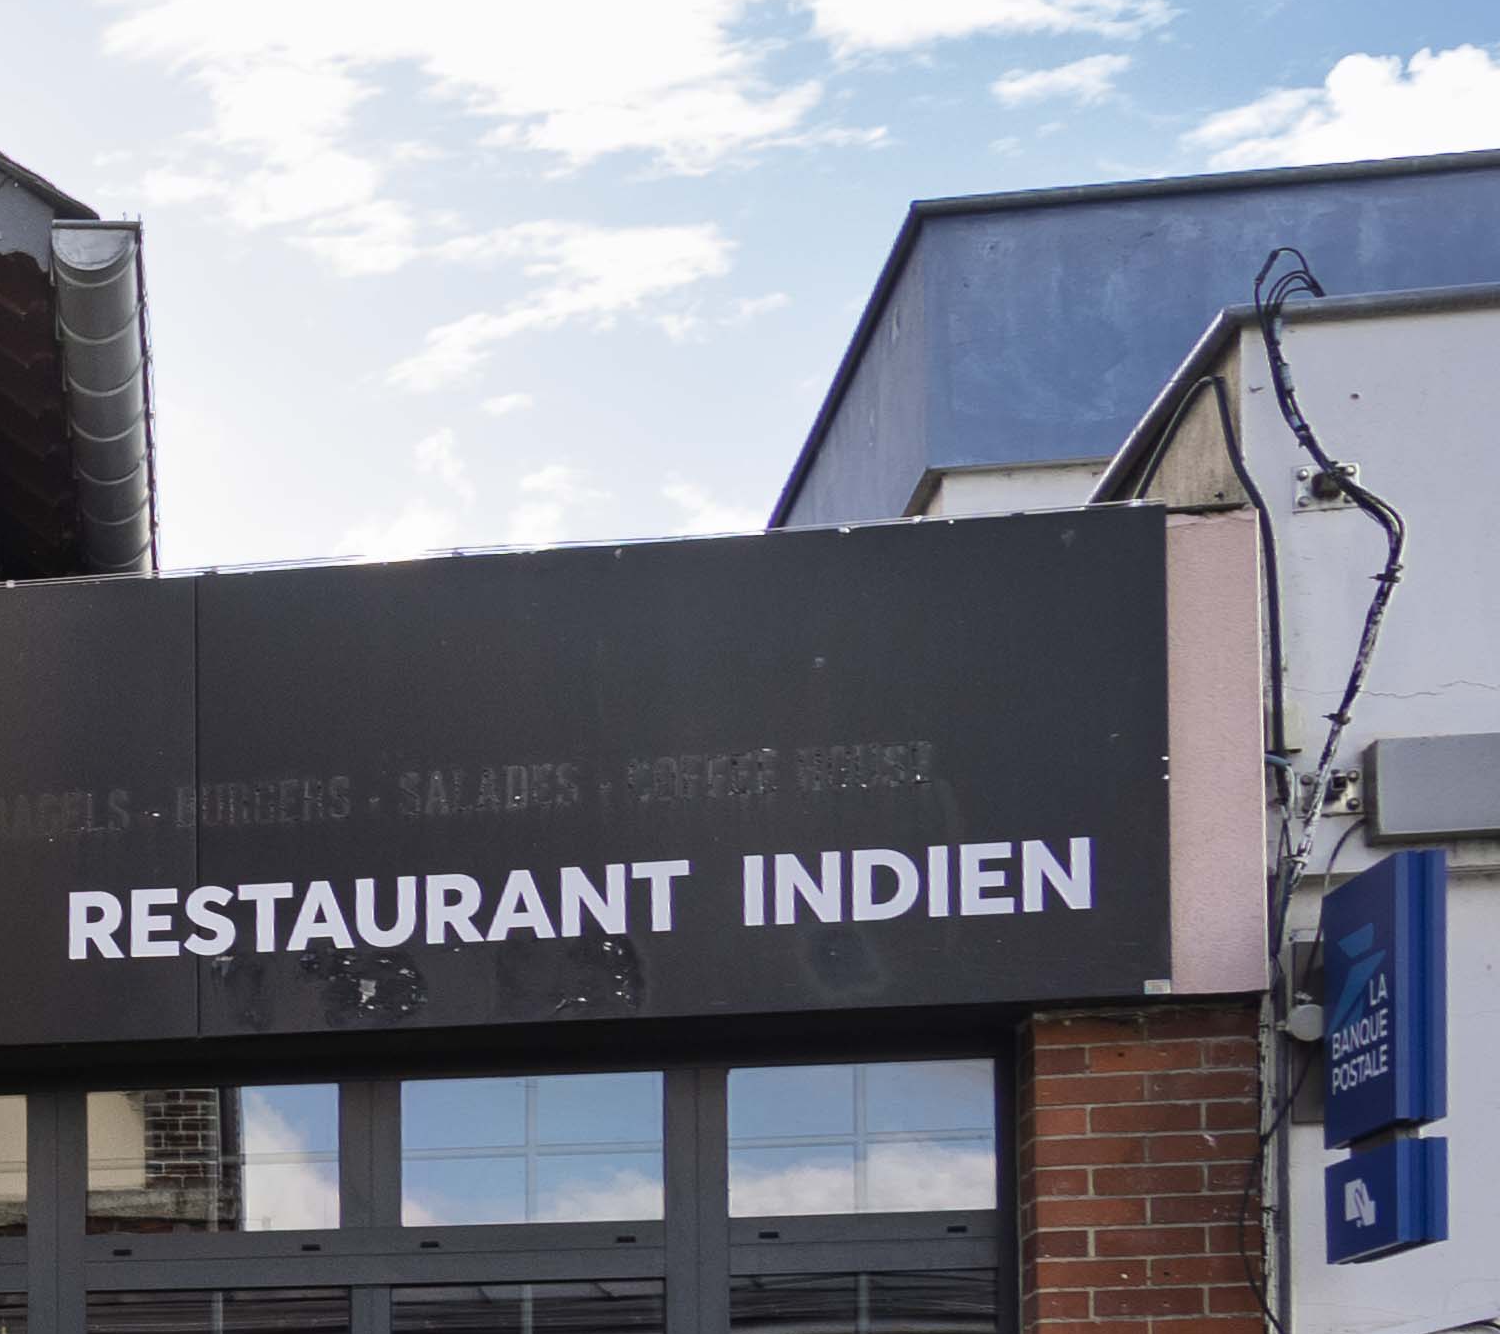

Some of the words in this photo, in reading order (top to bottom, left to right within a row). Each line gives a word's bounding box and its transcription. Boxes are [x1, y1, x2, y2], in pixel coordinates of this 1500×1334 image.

[67, 859, 690, 960] RESTAURANT
[742, 835, 1093, 927] INDIEN
[1369, 972, 1389, 1007] LA
[1332, 1007, 1389, 1061] BANQUE
[1332, 1043, 1389, 1096] POSTALE
